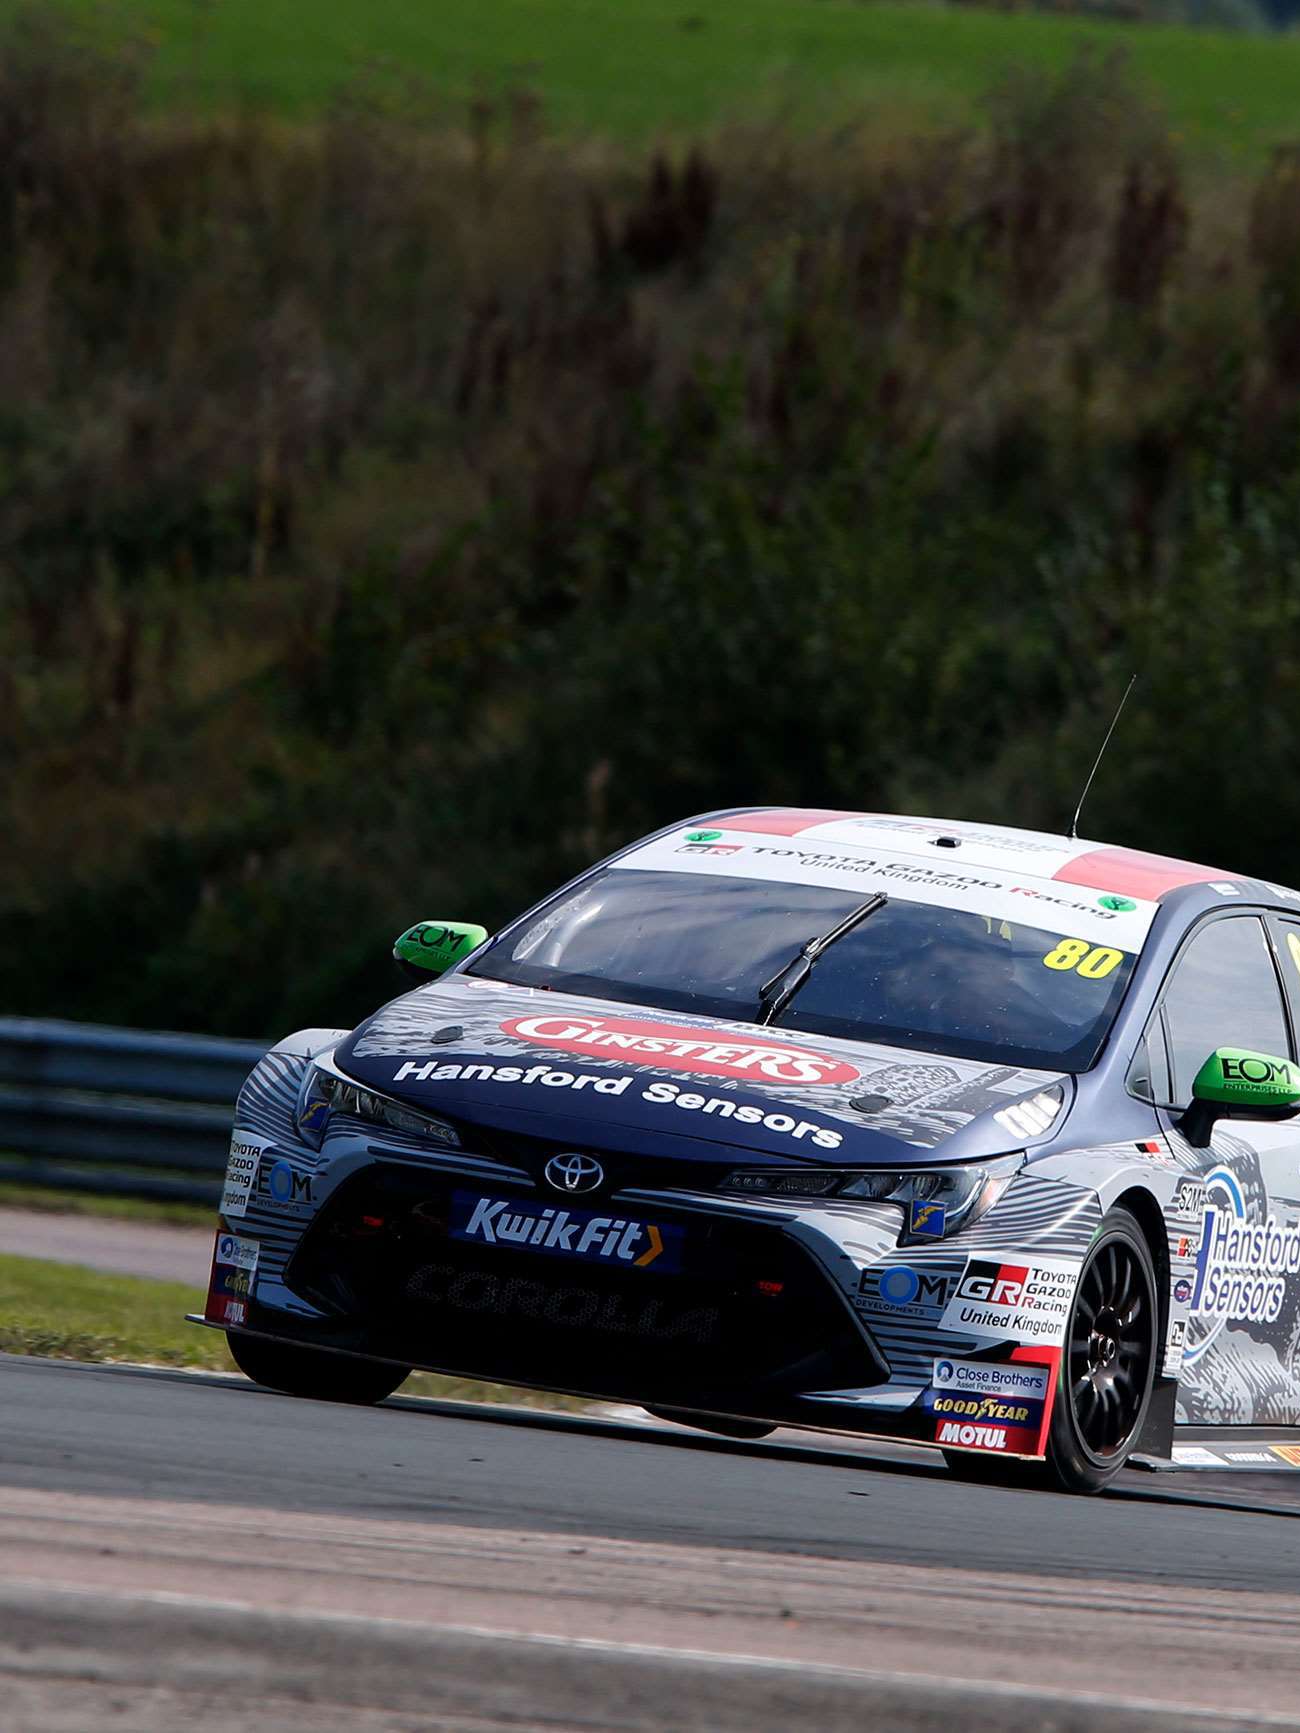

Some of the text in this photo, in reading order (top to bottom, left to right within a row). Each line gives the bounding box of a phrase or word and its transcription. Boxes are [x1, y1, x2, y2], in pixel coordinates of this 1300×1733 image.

[752, 847, 876, 867] TOYOTA
[886, 863, 1003, 889] GAZOO
[1009, 886, 1118, 920] Racing
[800, 858, 969, 891] United Kingdom
[406, 923, 468, 952] EOM
[1043, 938, 1124, 979] 80
[514, 1016, 841, 1082] GINSTERS
[1221, 1058, 1291, 1084] EOM
[393, 1060, 844, 1150] Hansford Sensors
[258, 1160, 312, 1202] EOM
[858, 1266, 949, 1306] EOM
[960, 1276, 1022, 1306] GR
[1026, 1283, 1072, 1299] GAZOO
[1032, 1268, 1078, 1285] TOYOTA
[1203, 1266, 1283, 1317] Sensors
[856, 1298, 926, 1316] DEVELOPMENTS
[960, 1307, 1011, 1328] United
[1021, 1297, 1067, 1317] Racing
[955, 1381, 1002, 1393] Asset Finance
[956, 1367, 1043, 1389] Close Brothers
[939, 1422, 1007, 1448] MOTUL
